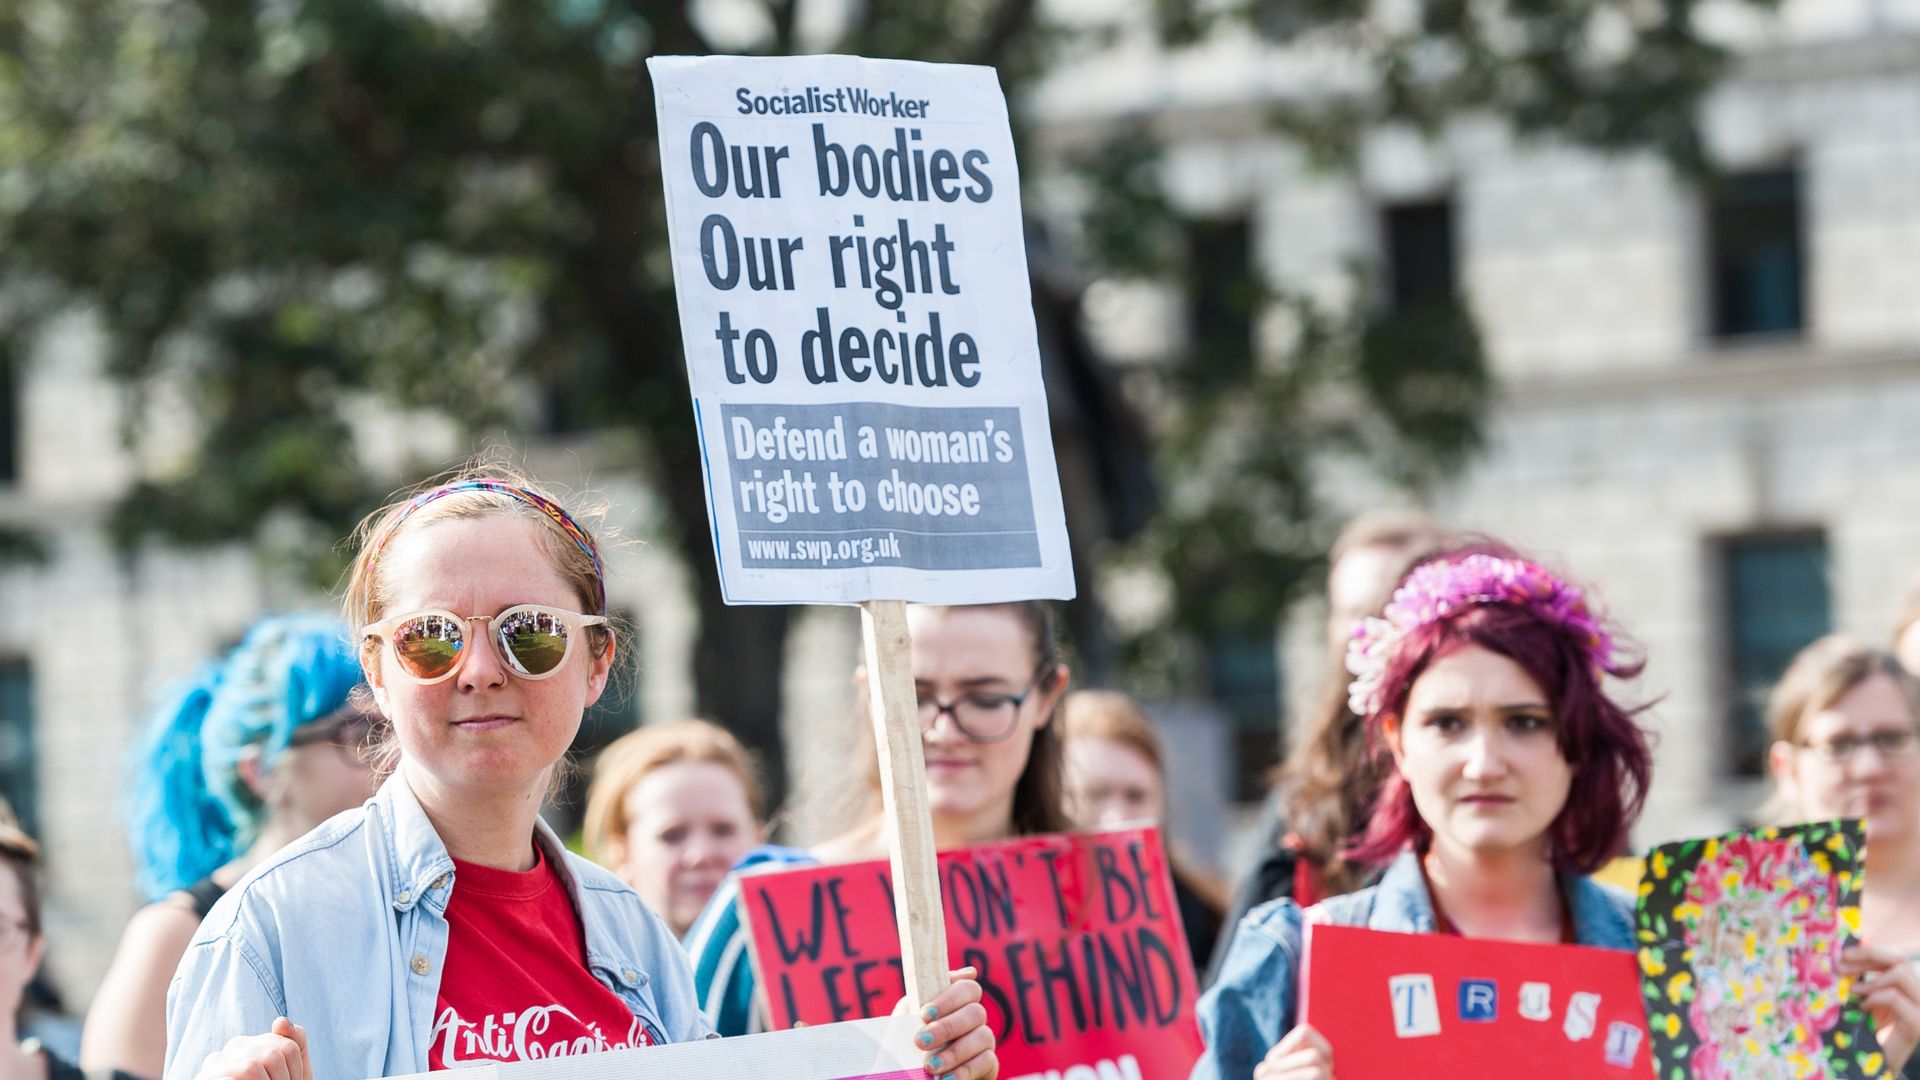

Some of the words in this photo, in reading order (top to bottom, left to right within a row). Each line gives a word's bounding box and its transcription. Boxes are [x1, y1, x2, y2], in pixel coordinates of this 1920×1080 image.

[690, 121, 789, 198] Our
[812, 123, 993, 203] bodies
[700, 213, 803, 291] Our
[829, 214, 960, 310] right
[715, 311, 778, 385] to
[801, 307, 981, 388] decide
[731, 416, 847, 461] Defend
[858, 426, 878, 459] a
[885, 420, 1013, 463] woman's
[740, 469, 820, 523] right
[828, 471, 866, 512] to
[877, 469, 980, 516] choose
[748, 532, 901, 565] www.swp.org.uk
[759, 877, 860, 966] WE
[1095, 843, 1161, 924] BE
[963, 926, 1180, 1046] BEHIND
[1394, 982, 1642, 1055] TRUST
